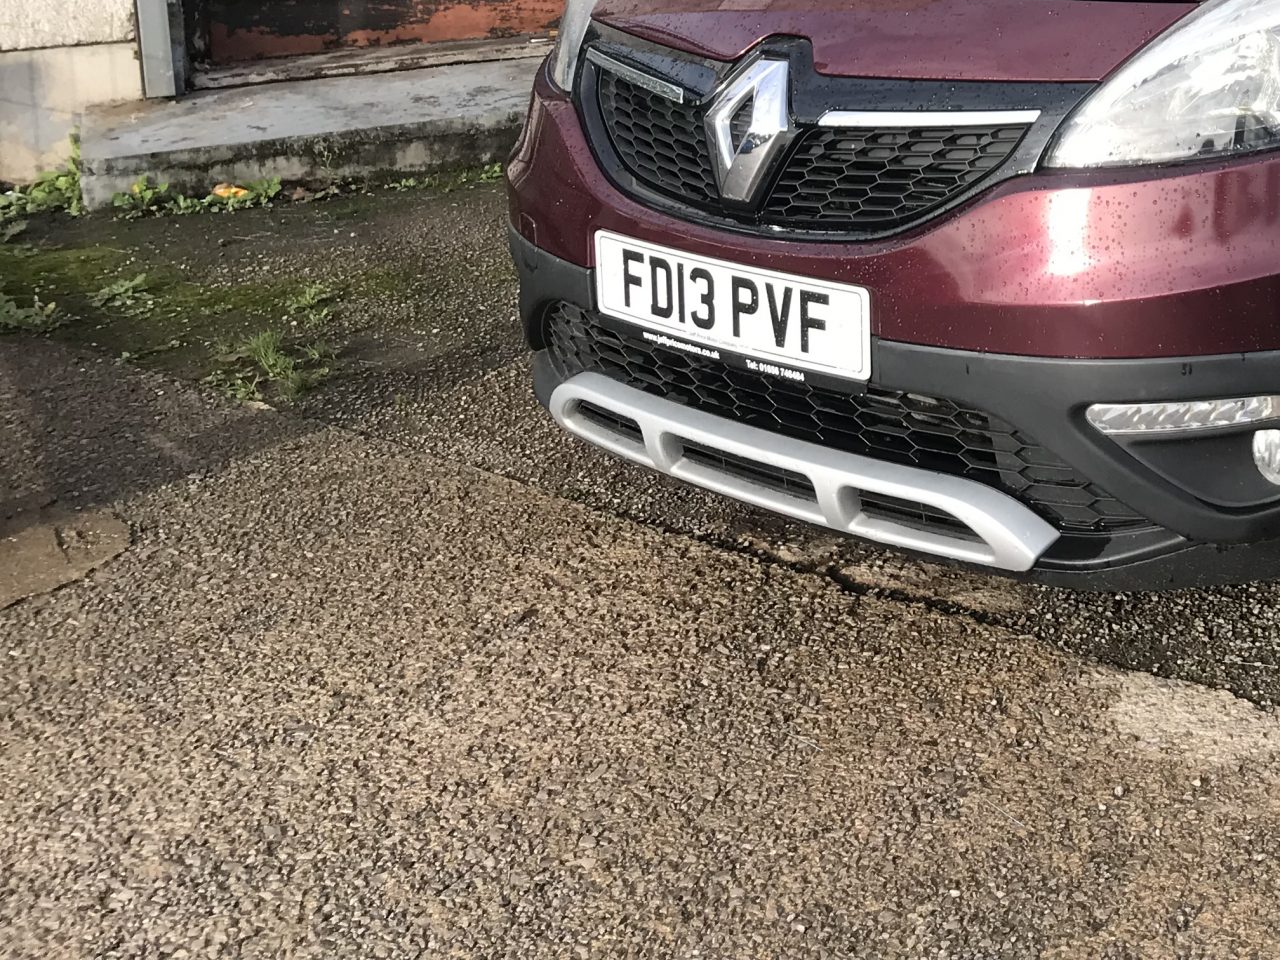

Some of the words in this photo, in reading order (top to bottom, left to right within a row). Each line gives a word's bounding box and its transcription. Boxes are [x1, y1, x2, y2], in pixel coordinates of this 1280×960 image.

[622, 248, 716, 331] FD13
[731, 275, 830, 354] PVF
[745, 358, 759, 371] Tel:
